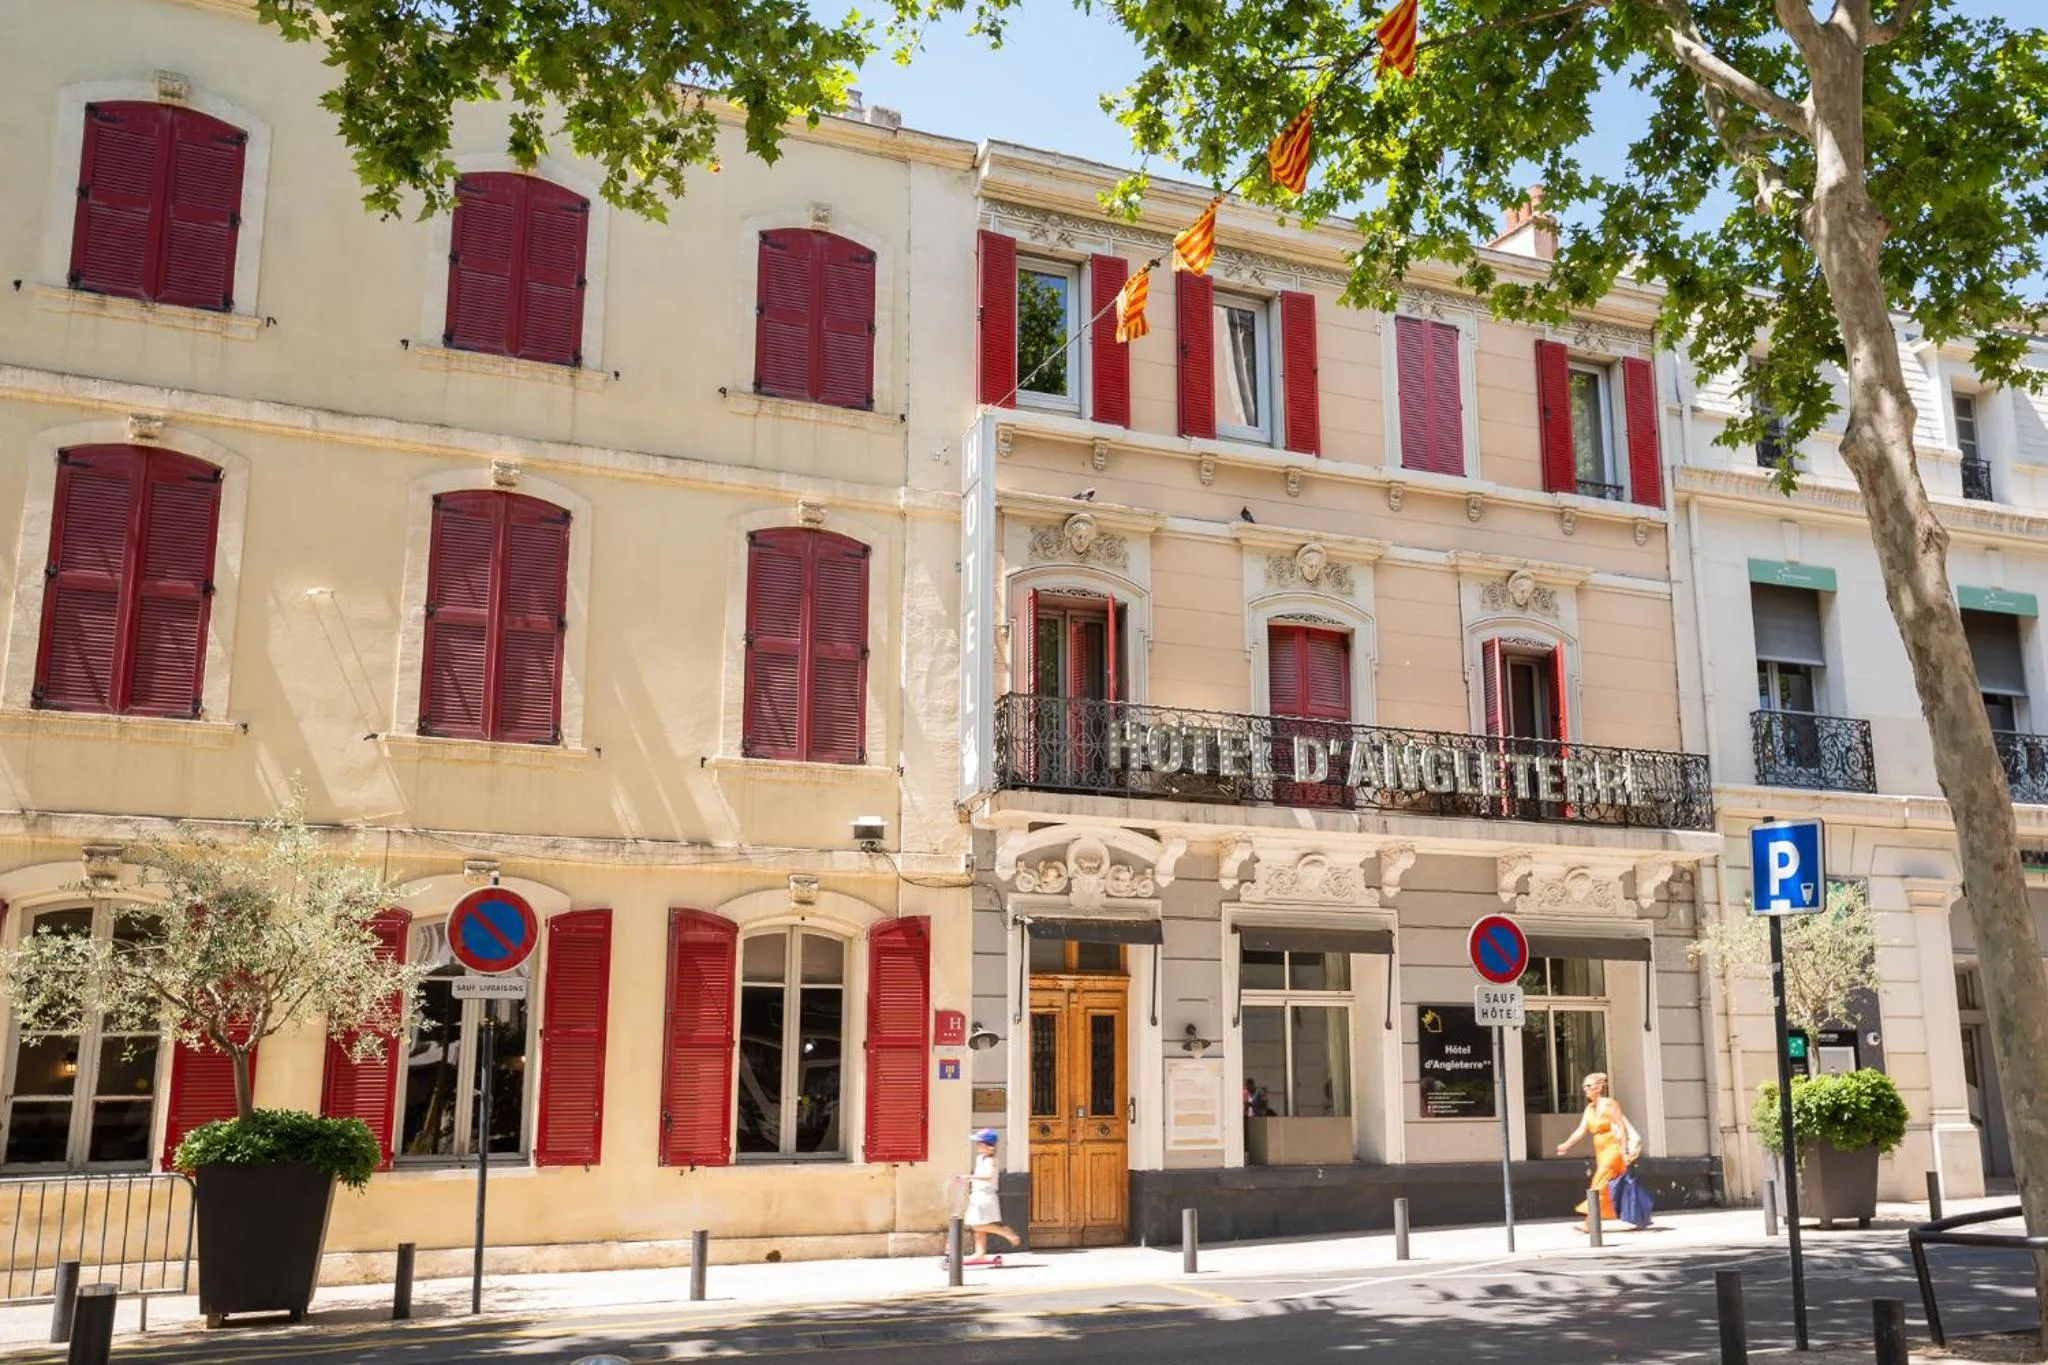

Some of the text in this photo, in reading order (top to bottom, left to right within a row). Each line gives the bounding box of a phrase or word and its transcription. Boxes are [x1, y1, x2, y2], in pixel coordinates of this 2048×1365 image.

[966, 433, 978, 713] HOTEL
[1109, 720, 1278, 780] HOTEL
[1769, 841, 1800, 896] P
[457, 984, 475, 992] SAUF
[1485, 993, 1515, 1003] SAUF
[1482, 1007, 1519, 1019] HÔTE
[949, 1016, 961, 1030] H
[1445, 1044, 1471, 1054] Hôtel
